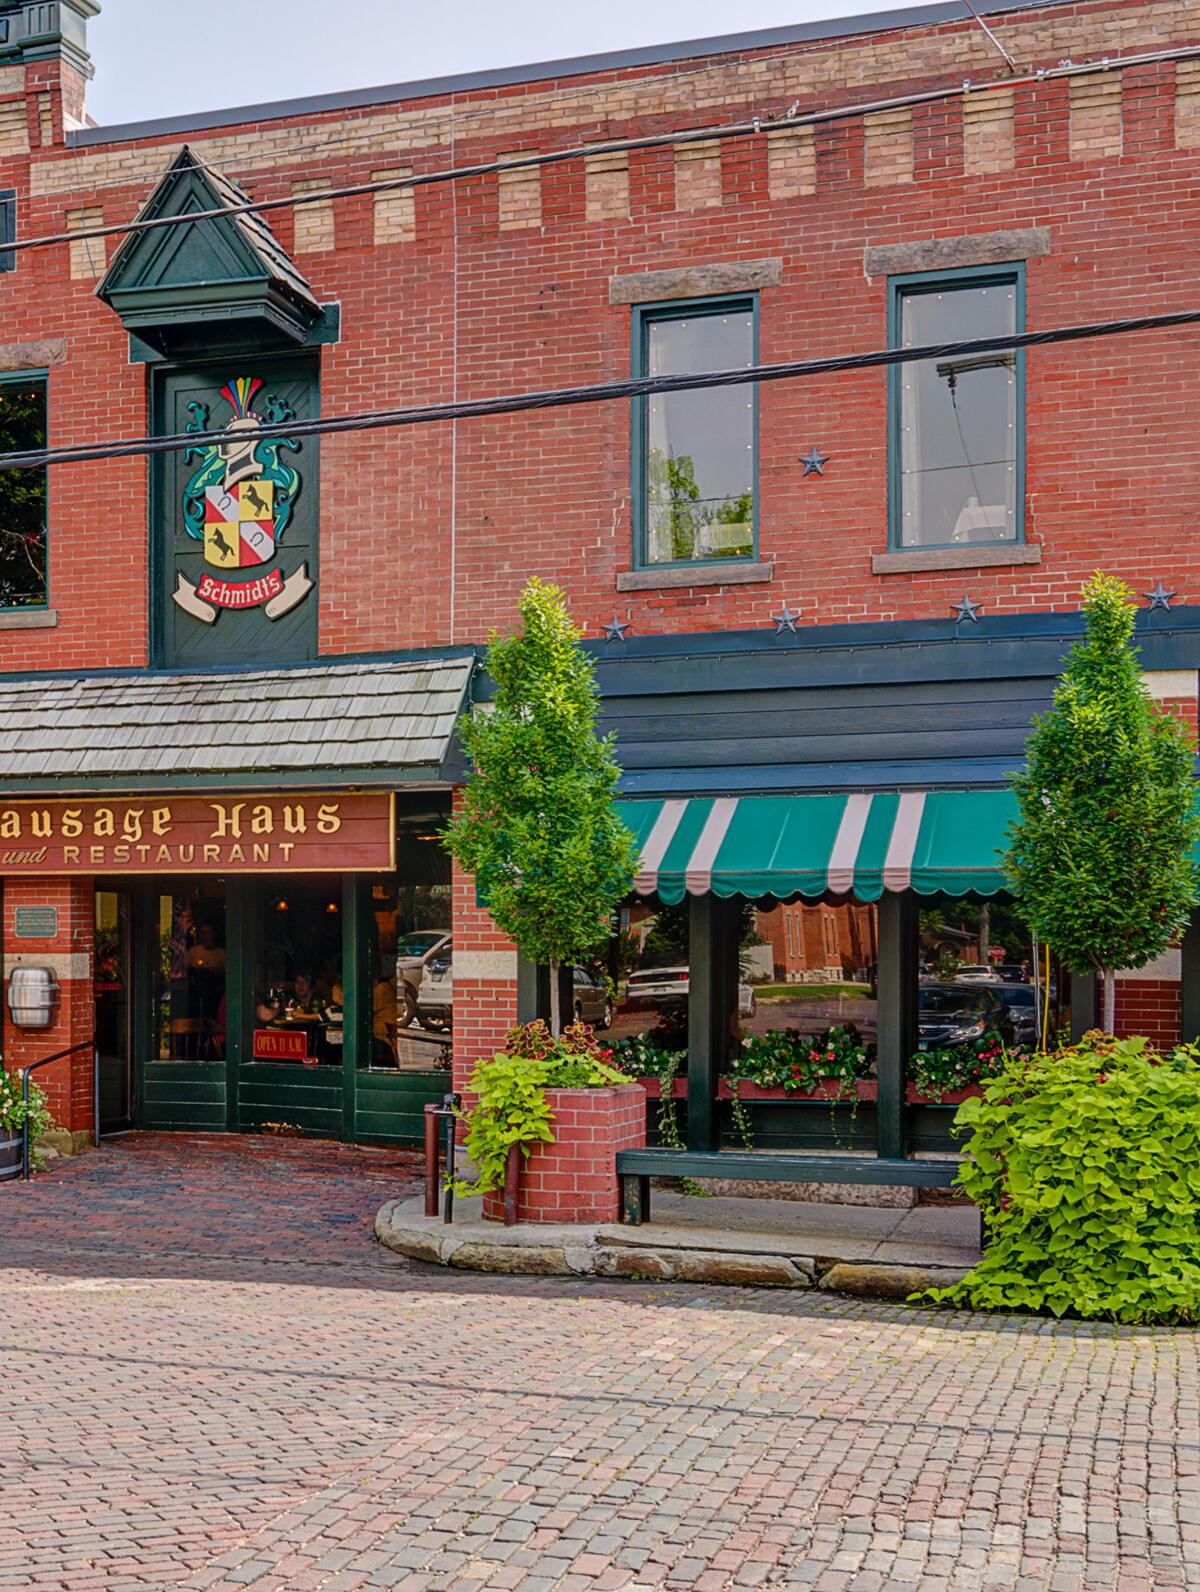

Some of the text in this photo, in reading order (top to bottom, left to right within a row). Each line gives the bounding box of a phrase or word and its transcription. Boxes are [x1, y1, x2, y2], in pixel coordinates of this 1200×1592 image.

[198, 575, 280, 607] Schmidt's
[209, 803, 342, 839] Haus
[1, 843, 295, 865] und RESTAURANT
[256, 1035, 277, 1052] OPEN
